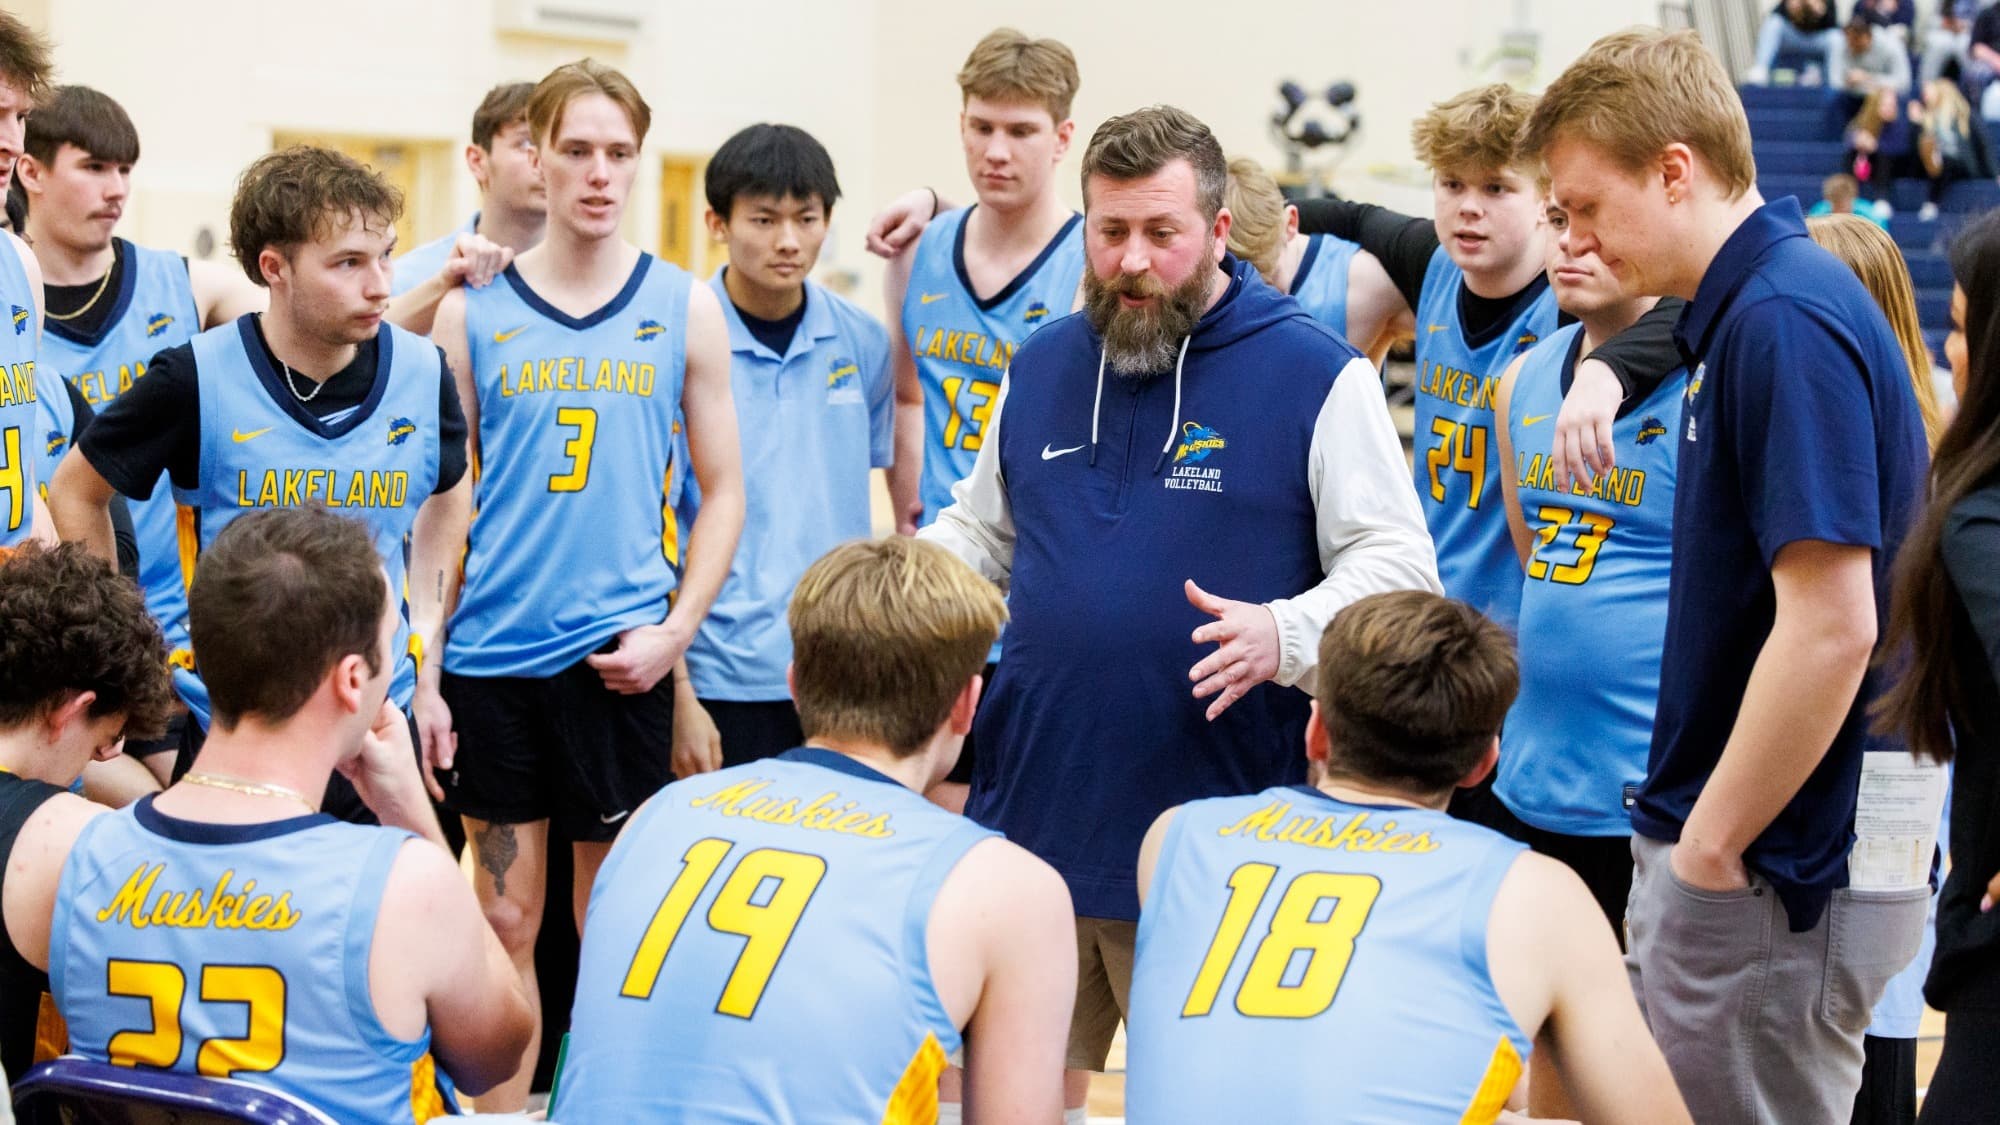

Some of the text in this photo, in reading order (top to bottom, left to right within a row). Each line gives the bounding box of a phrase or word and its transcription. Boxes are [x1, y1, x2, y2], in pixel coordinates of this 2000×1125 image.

[500, 357, 655, 398] LAKELAND
[941, 376, 1001, 451] 13
[548, 407, 599, 493] 3
[1171, 466, 1222, 480] LAKELAND
[1426, 416, 1488, 510] 24
[1517, 451, 1646, 507] LAKAND
[238, 468, 409, 508] LAKELAND
[1164, 478, 1223, 493] VOLLEYBALL
[1527, 505, 1616, 586] 23
[691, 777, 897, 839] Muskies
[1218, 800, 1442, 854] Muskies
[96, 862, 303, 931] Muskies
[618, 837, 828, 1021] 19
[1179, 861, 1383, 1020] 18
